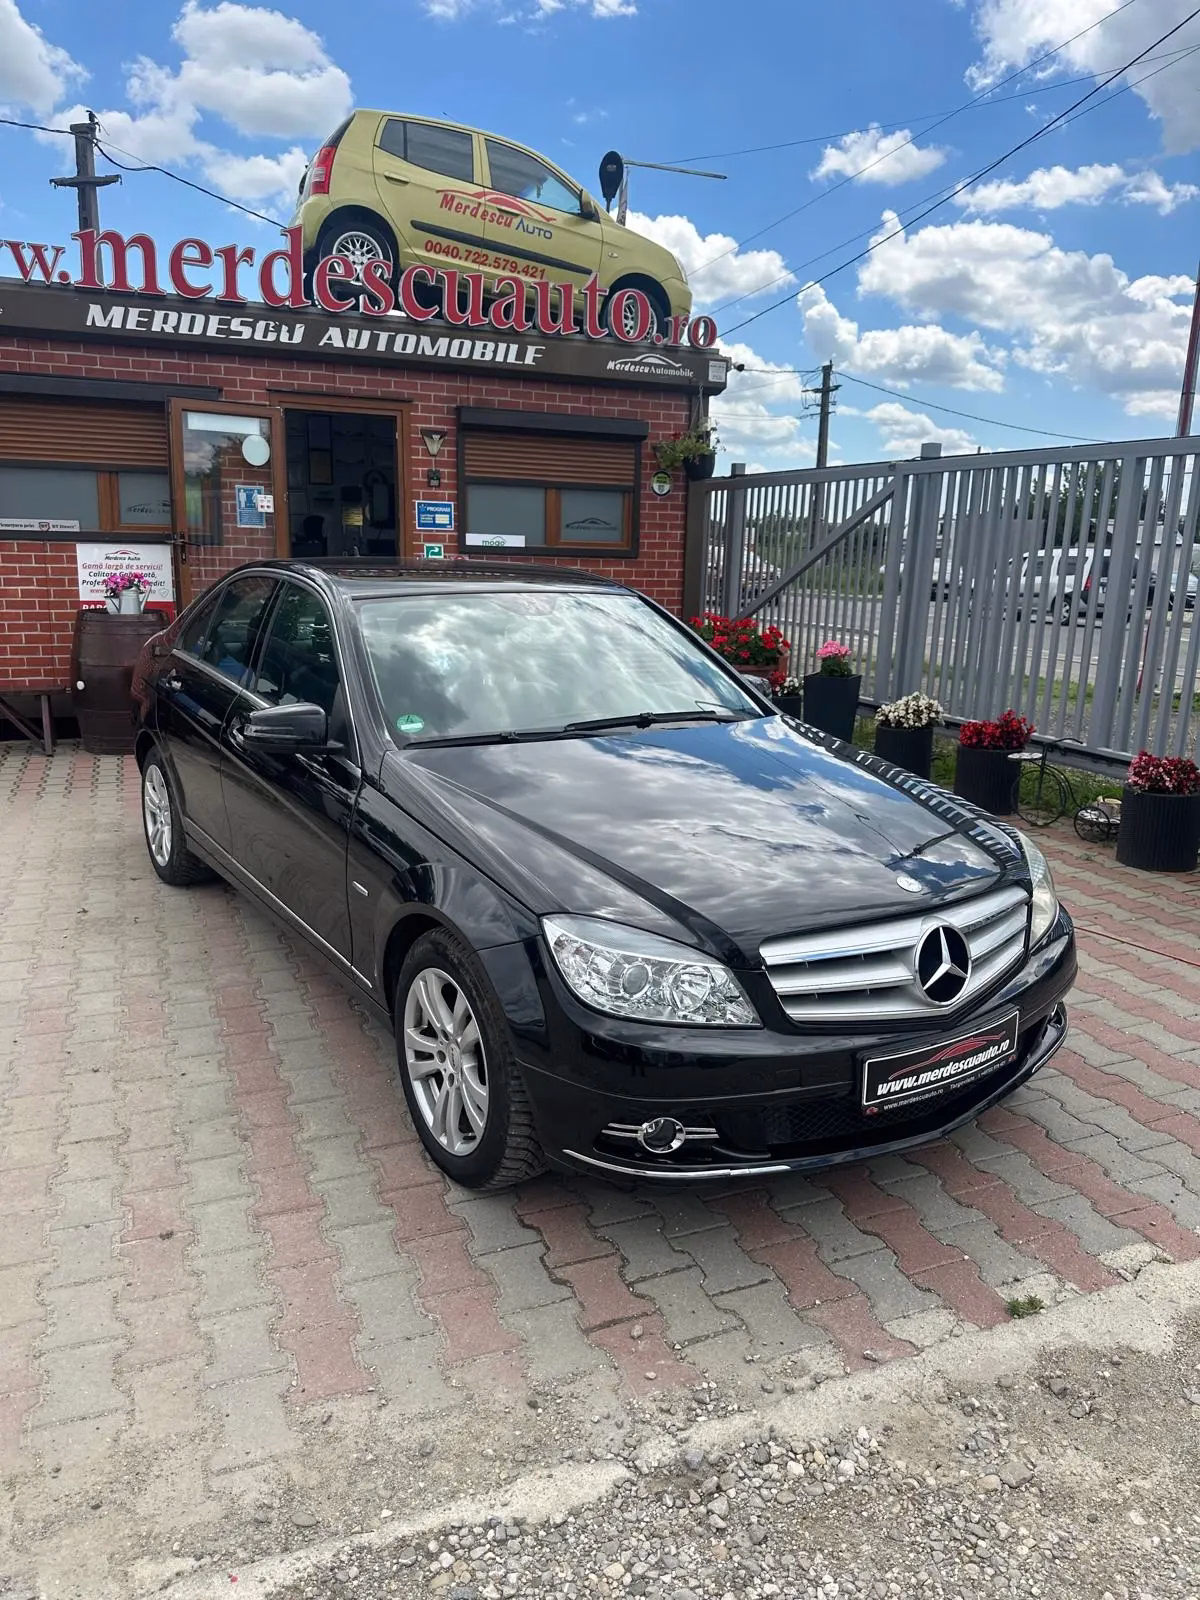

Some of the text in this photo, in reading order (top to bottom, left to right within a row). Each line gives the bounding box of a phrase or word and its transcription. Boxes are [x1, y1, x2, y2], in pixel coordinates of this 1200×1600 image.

[440, 192, 514, 228] Merdescu
[425, 240, 546, 281] 0040.722.579.421
[0, 222, 719, 350] w.merdescuauto.ro
[86, 303, 547, 366] MERDESCU AUTOMOBILE
[876, 1039, 1010, 1096] www.merdescuauto.ro
[883, 1088, 944, 1110] www.merdescuauto.ro
